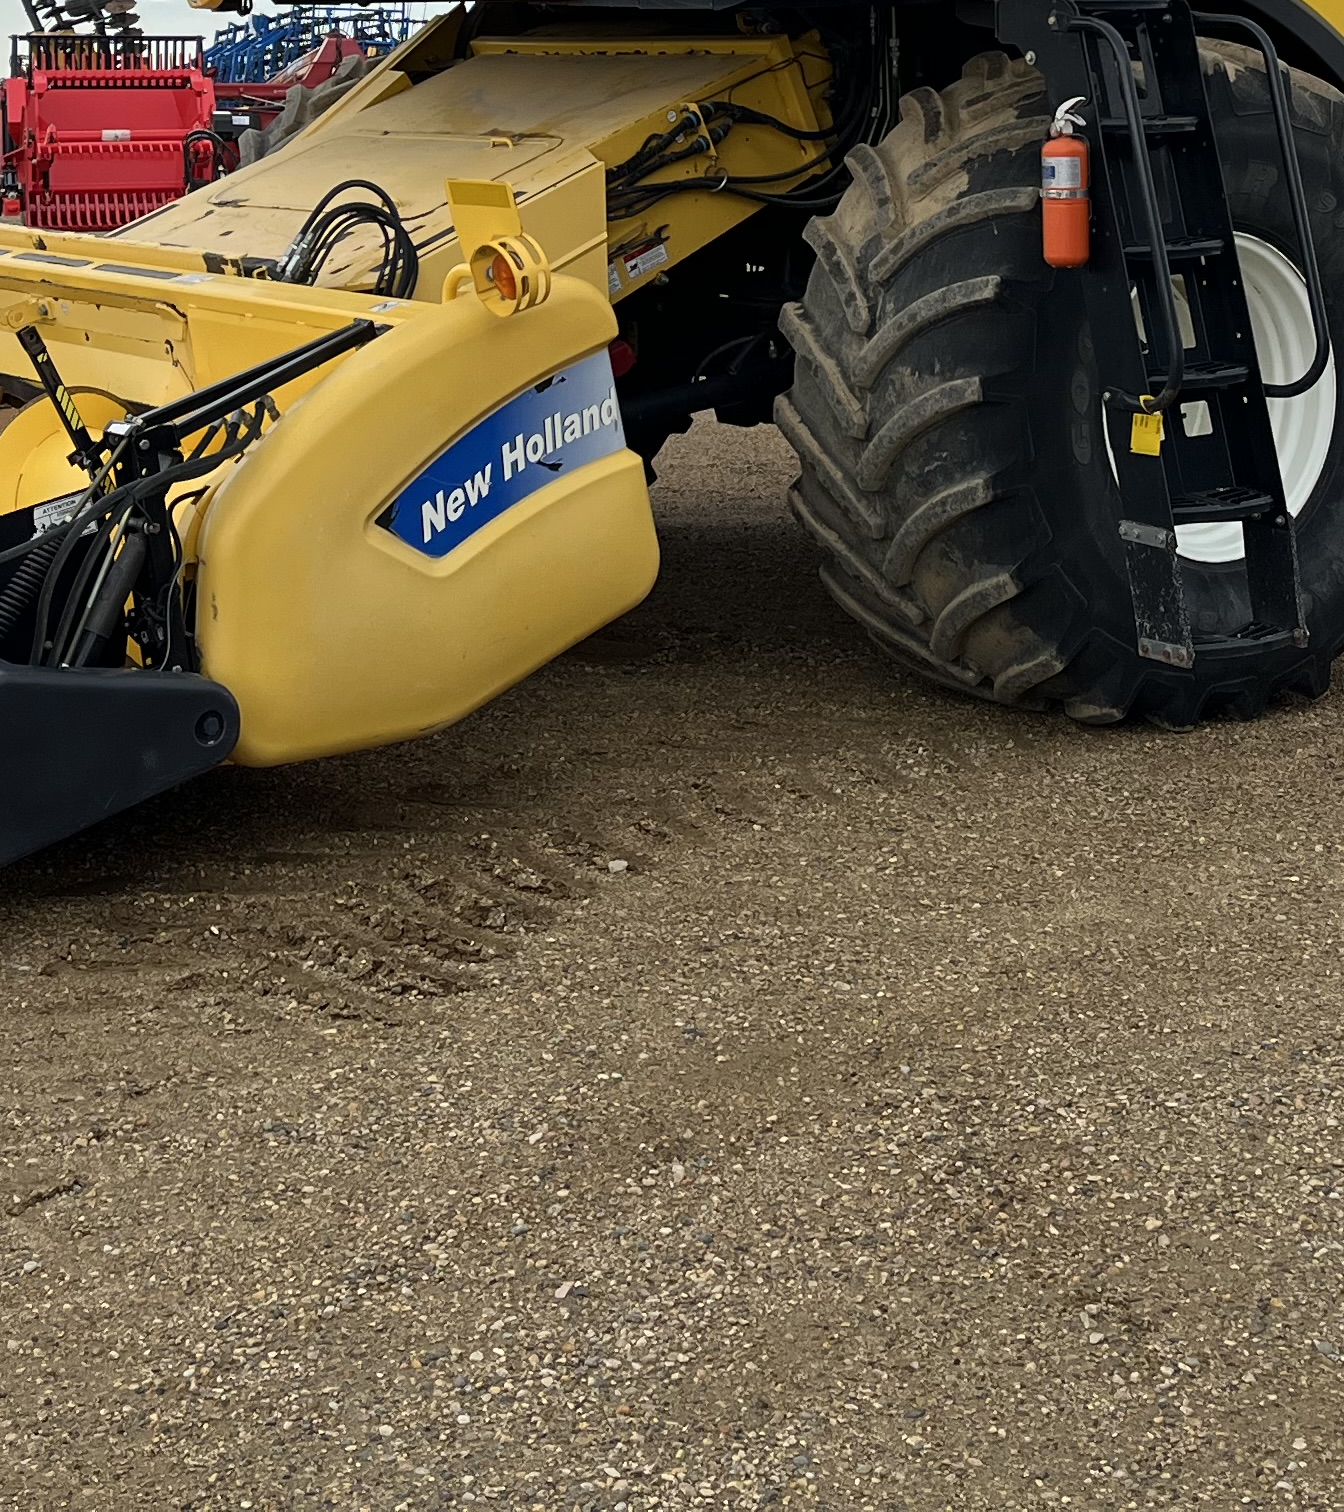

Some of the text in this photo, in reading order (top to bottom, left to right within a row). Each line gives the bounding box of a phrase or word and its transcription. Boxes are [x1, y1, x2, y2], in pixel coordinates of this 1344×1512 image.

[42, 499, 76, 514] ATTENTION
[420, 386, 619, 544] New Holland
